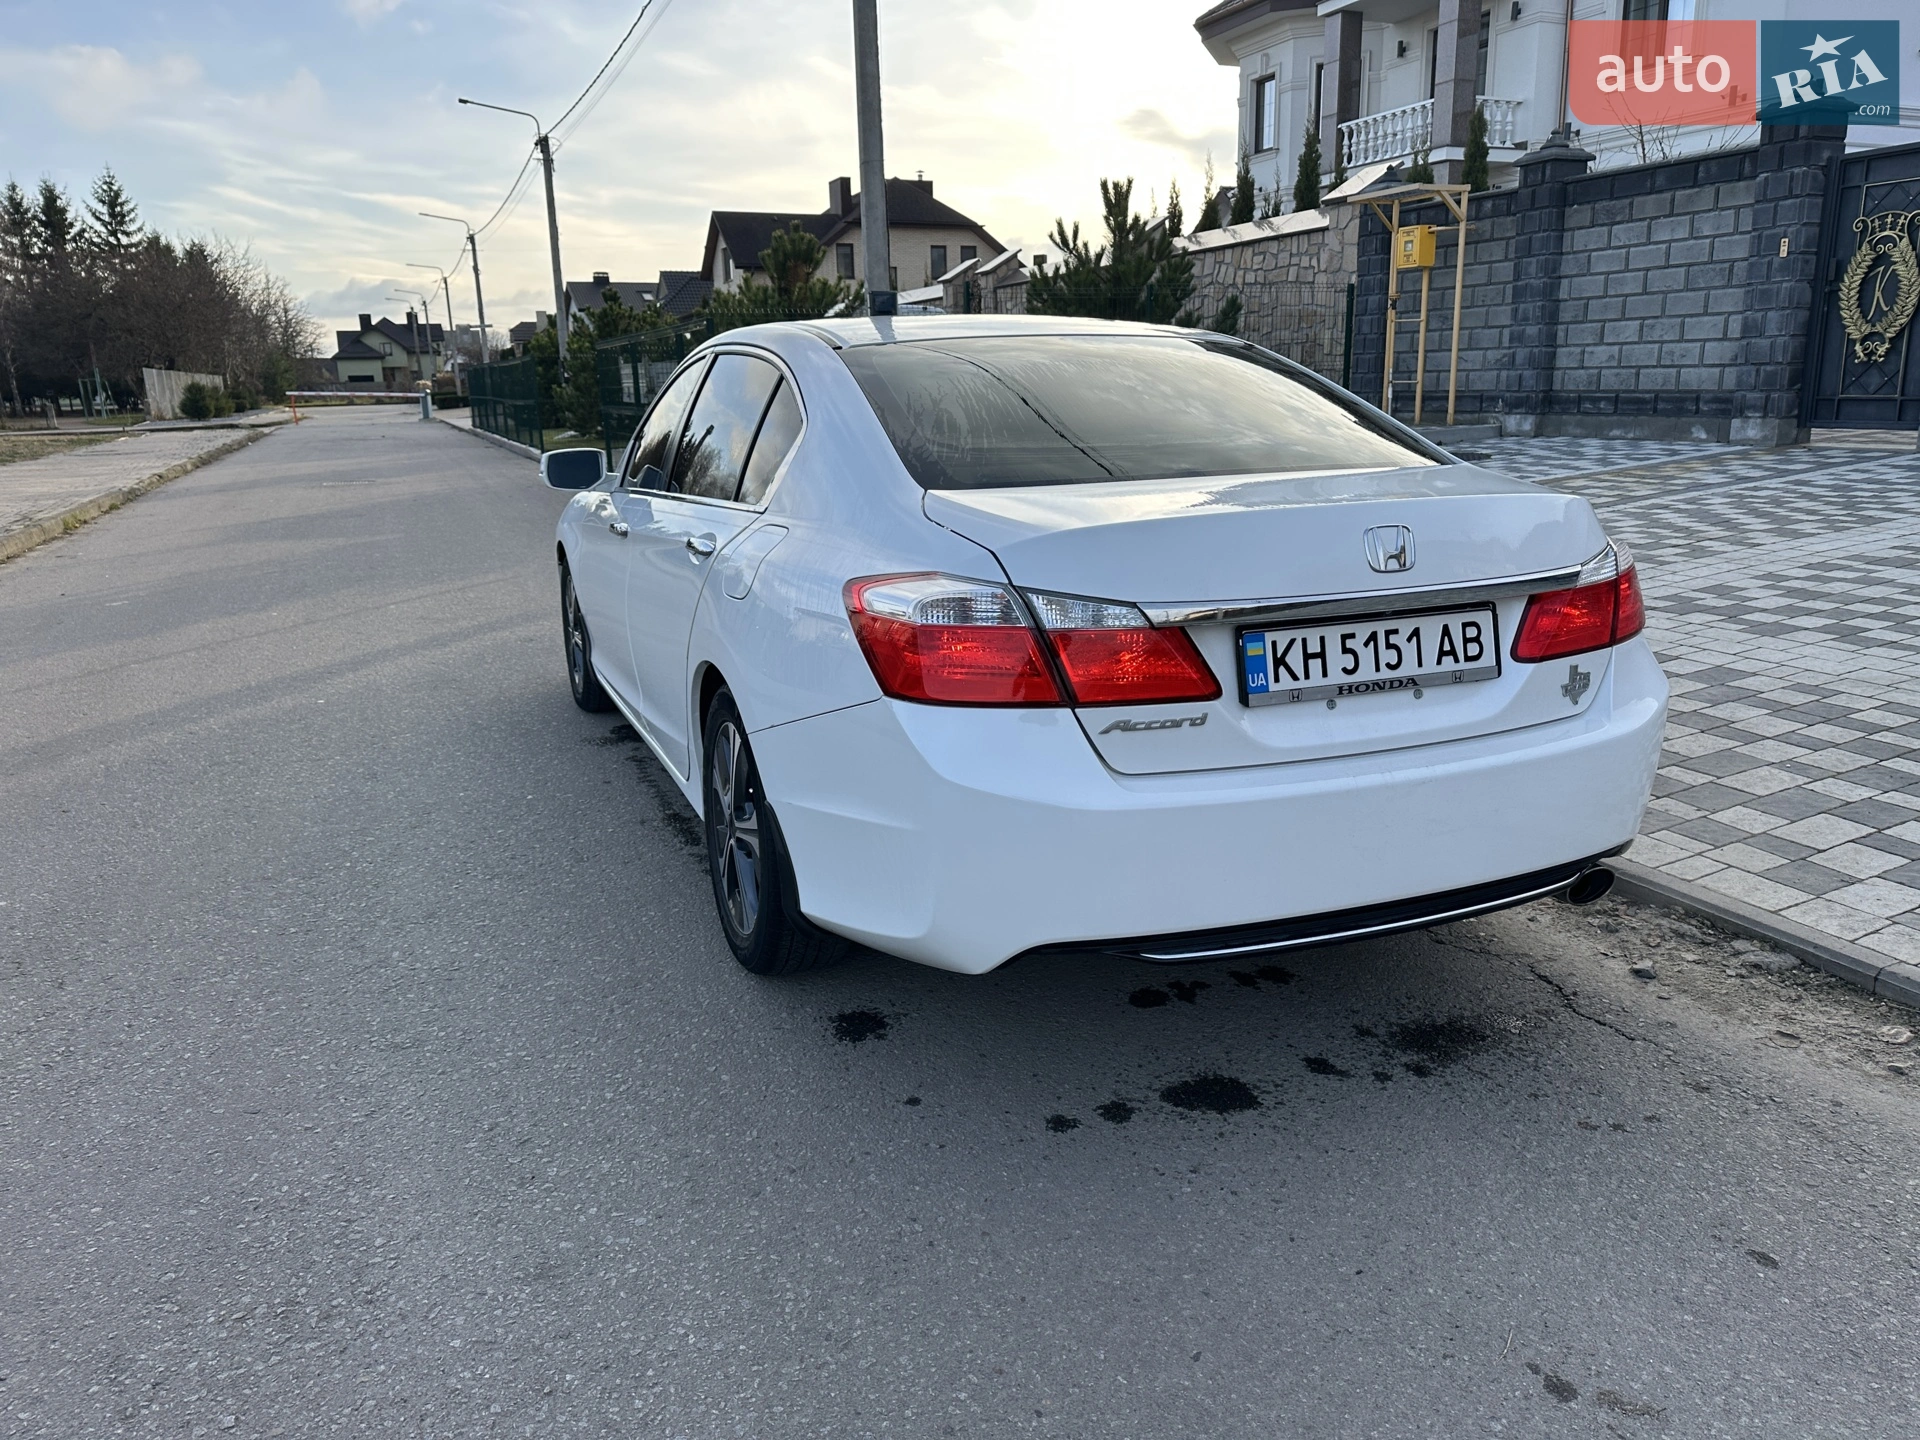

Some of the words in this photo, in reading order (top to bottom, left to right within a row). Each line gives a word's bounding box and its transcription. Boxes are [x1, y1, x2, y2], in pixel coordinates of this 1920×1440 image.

[1271, 635, 1328, 684] KH
[1340, 627, 1423, 676] 5151
[1436, 621, 1484, 666] AB
[1249, 673, 1267, 688] UA
[1337, 677, 1419, 696] HONDA
[1098, 712, 1209, 735] Accord
